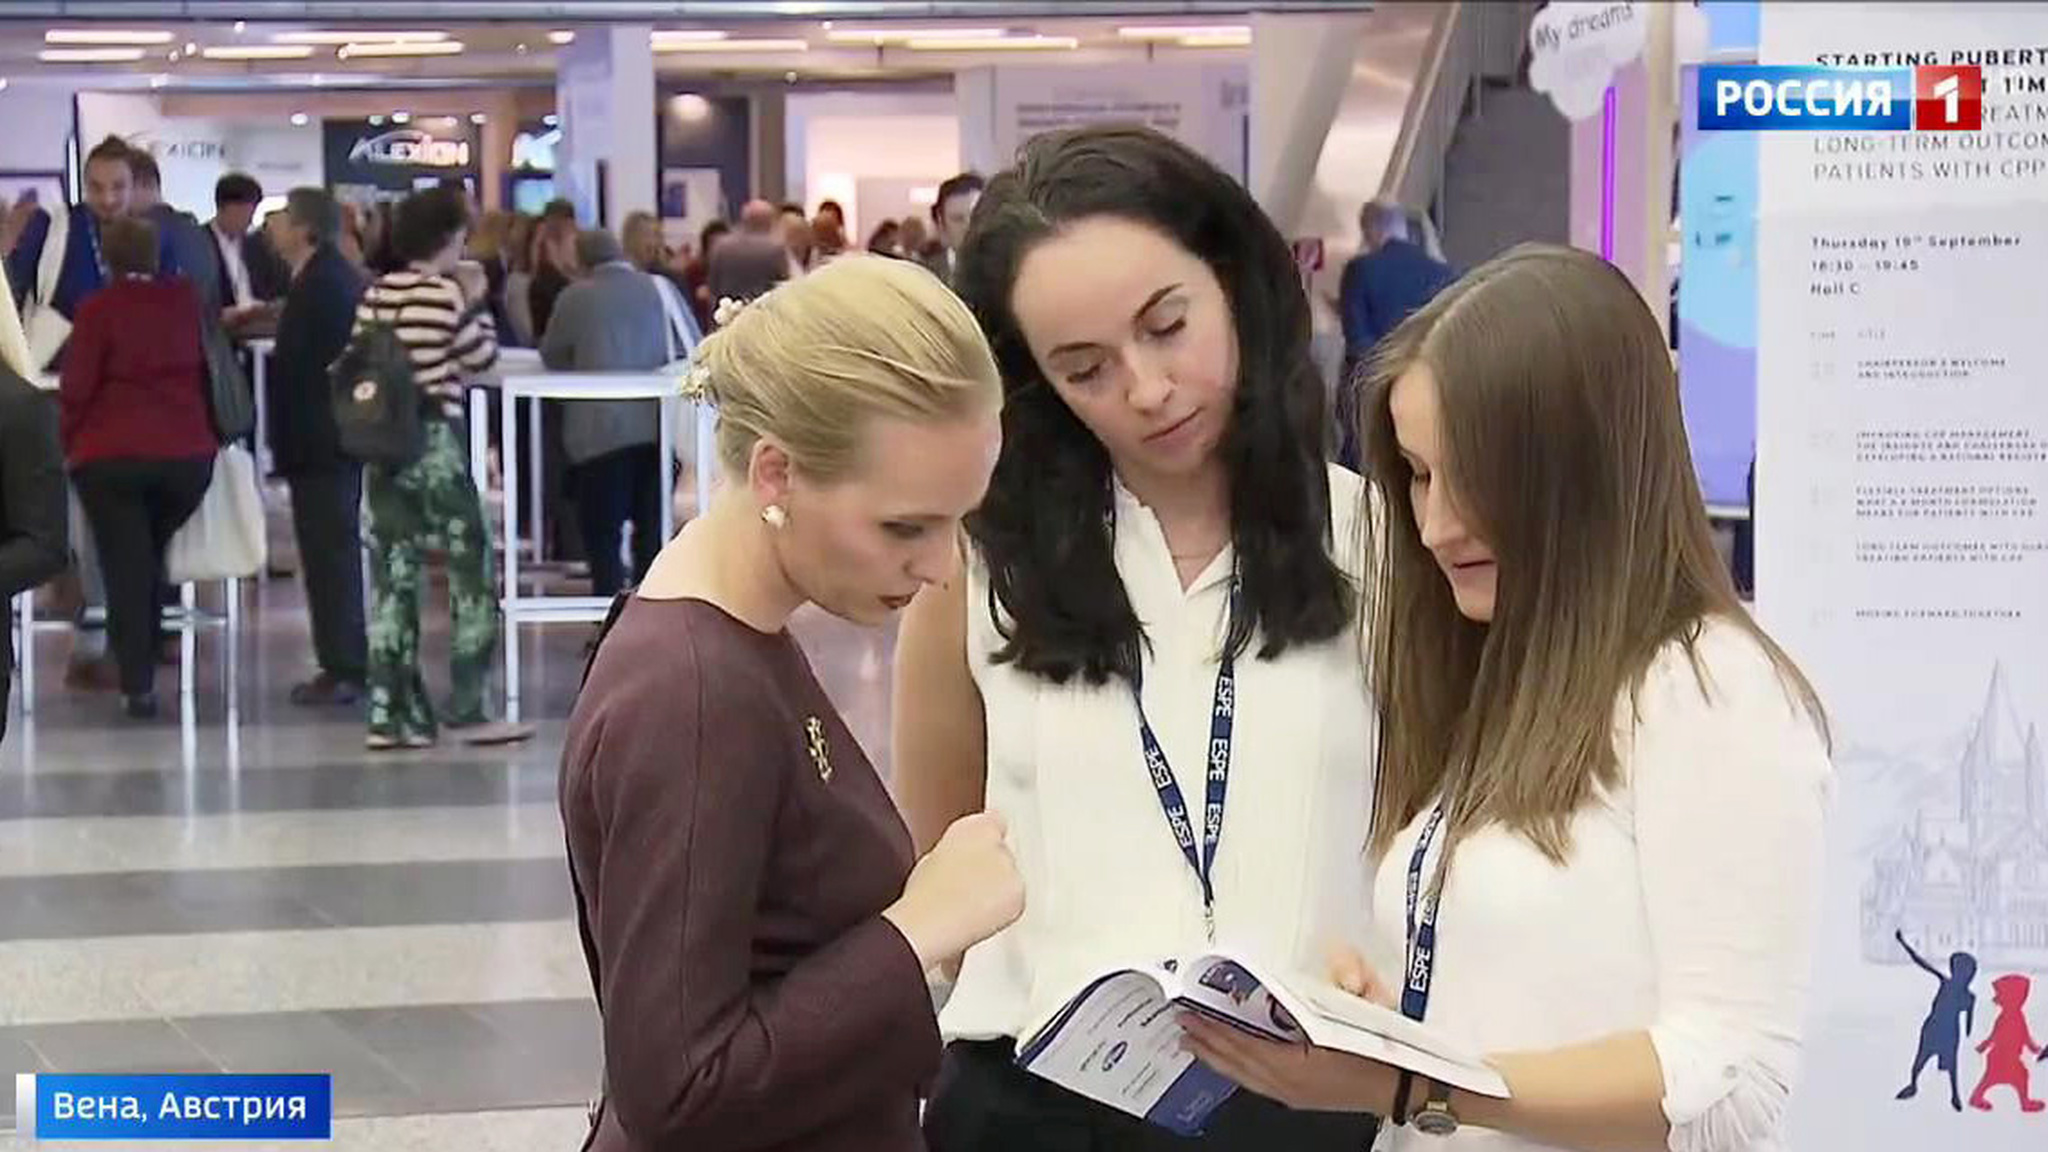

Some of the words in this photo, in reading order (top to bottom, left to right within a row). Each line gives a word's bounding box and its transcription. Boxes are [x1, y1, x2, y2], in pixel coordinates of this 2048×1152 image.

[1535, 24, 1562, 50] My
[1568, 4, 1635, 39] dreams
[1814, 163, 1923, 181] PATIENTS
[1934, 161, 1990, 179] WITH
[2000, 159, 2046, 177] CPP
[1812, 236, 1888, 251] Thursday
[1928, 234, 2022, 250] September
[1811, 282, 1845, 296] Hall
[1849, 281, 1861, 295] C
[1215, 676, 1233, 717] ESPE
[1145, 744, 1172, 789] ESPE
[1209, 737, 1229, 781] ESPE
[1167, 804, 1192, 848] ESPE
[1206, 802, 1222, 844] ESPE
[1409, 946, 1432, 992] ESPE
